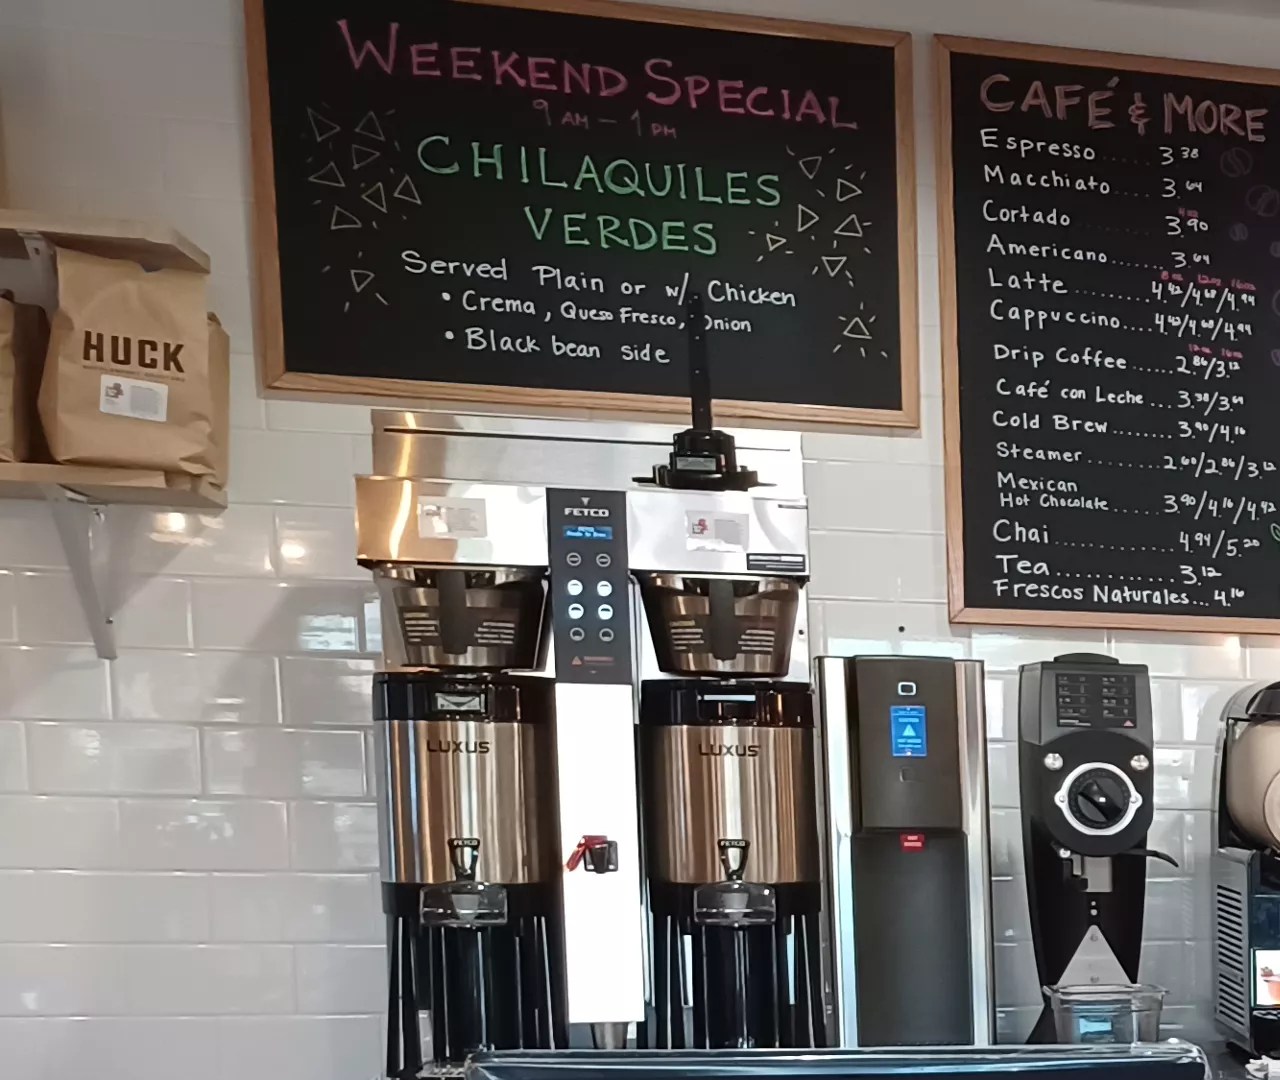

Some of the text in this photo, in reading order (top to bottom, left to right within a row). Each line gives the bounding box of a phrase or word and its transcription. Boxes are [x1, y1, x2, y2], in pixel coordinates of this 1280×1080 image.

[337, 19, 857, 134] WEEKEND SPECIAL
[980, 74, 1268, 142] CAFÉ & MORE
[562, 112, 588, 128] AM
[651, 123, 676, 138] PM
[980, 128, 1095, 159] Espresso
[418, 136, 780, 206] CHILAQUILES
[984, 165, 1109, 194] Macchiato
[983, 200, 1070, 225] Cortado
[524, 206, 716, 255] VERDES
[987, 234, 1107, 262] Americano
[402, 251, 795, 306] Served Plain or w/ Chicken
[989, 268, 1067, 293] Latte
[561, 301, 613, 320] Queso
[620, 307, 685, 329] Fresco,
[991, 299, 1119, 330] Cappuccino
[83, 330, 185, 373] HUCK
[465, 327, 670, 363] Black bean side
[994, 344, 1044, 368] Drip
[1056, 347, 1126, 369] Coffee
[997, 378, 1049, 398] Café
[1061, 389, 1085, 399] con
[1096, 386, 1143, 404] Leche
[993, 411, 1039, 429] Cold
[1053, 415, 1107, 432] Brew
[997, 442, 1082, 462] Steamer
[998, 472, 1077, 492] Mexican
[564, 507, 610, 517] FETCO
[1000, 493, 1030, 507] Hot
[1040, 494, 1108, 510] Chocolate
[993, 519, 1048, 543] Chai
[996, 555, 1049, 575] Tea
[993, 579, 1083, 600] Frescos
[1094, 585, 1189, 604] Naturales
[426, 740, 490, 754] LUXUS
[698, 743, 762, 757] LUXUS
